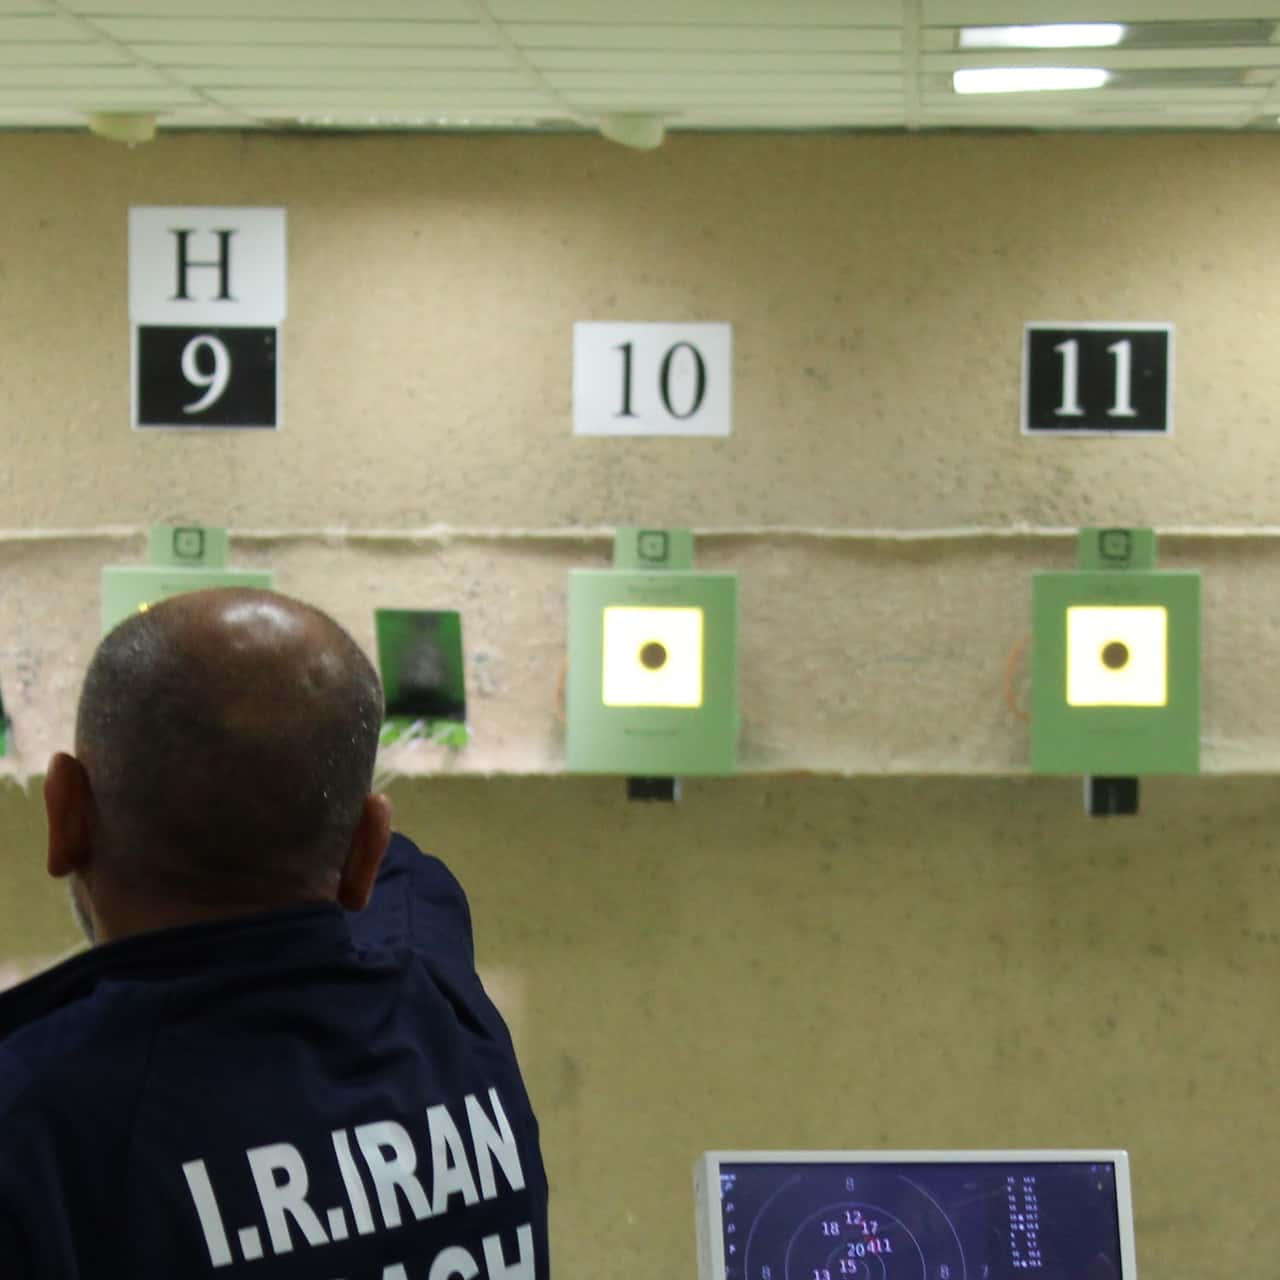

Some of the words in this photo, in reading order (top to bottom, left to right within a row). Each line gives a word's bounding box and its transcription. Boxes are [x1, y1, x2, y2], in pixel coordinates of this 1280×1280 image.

[169, 228, 236, 302] H
[180, 334, 232, 414] 9
[611, 342, 708, 419] 10
[1052, 339, 1139, 417] 11
[181, 1087, 526, 1268] I.R.IRAN
[821, 1221, 841, 1237] 18
[844, 1210, 862, 1226] 12
[861, 1220, 879, 1236] 17
[839, 1258, 858, 1275] 15
[847, 1242, 866, 1258] 20
